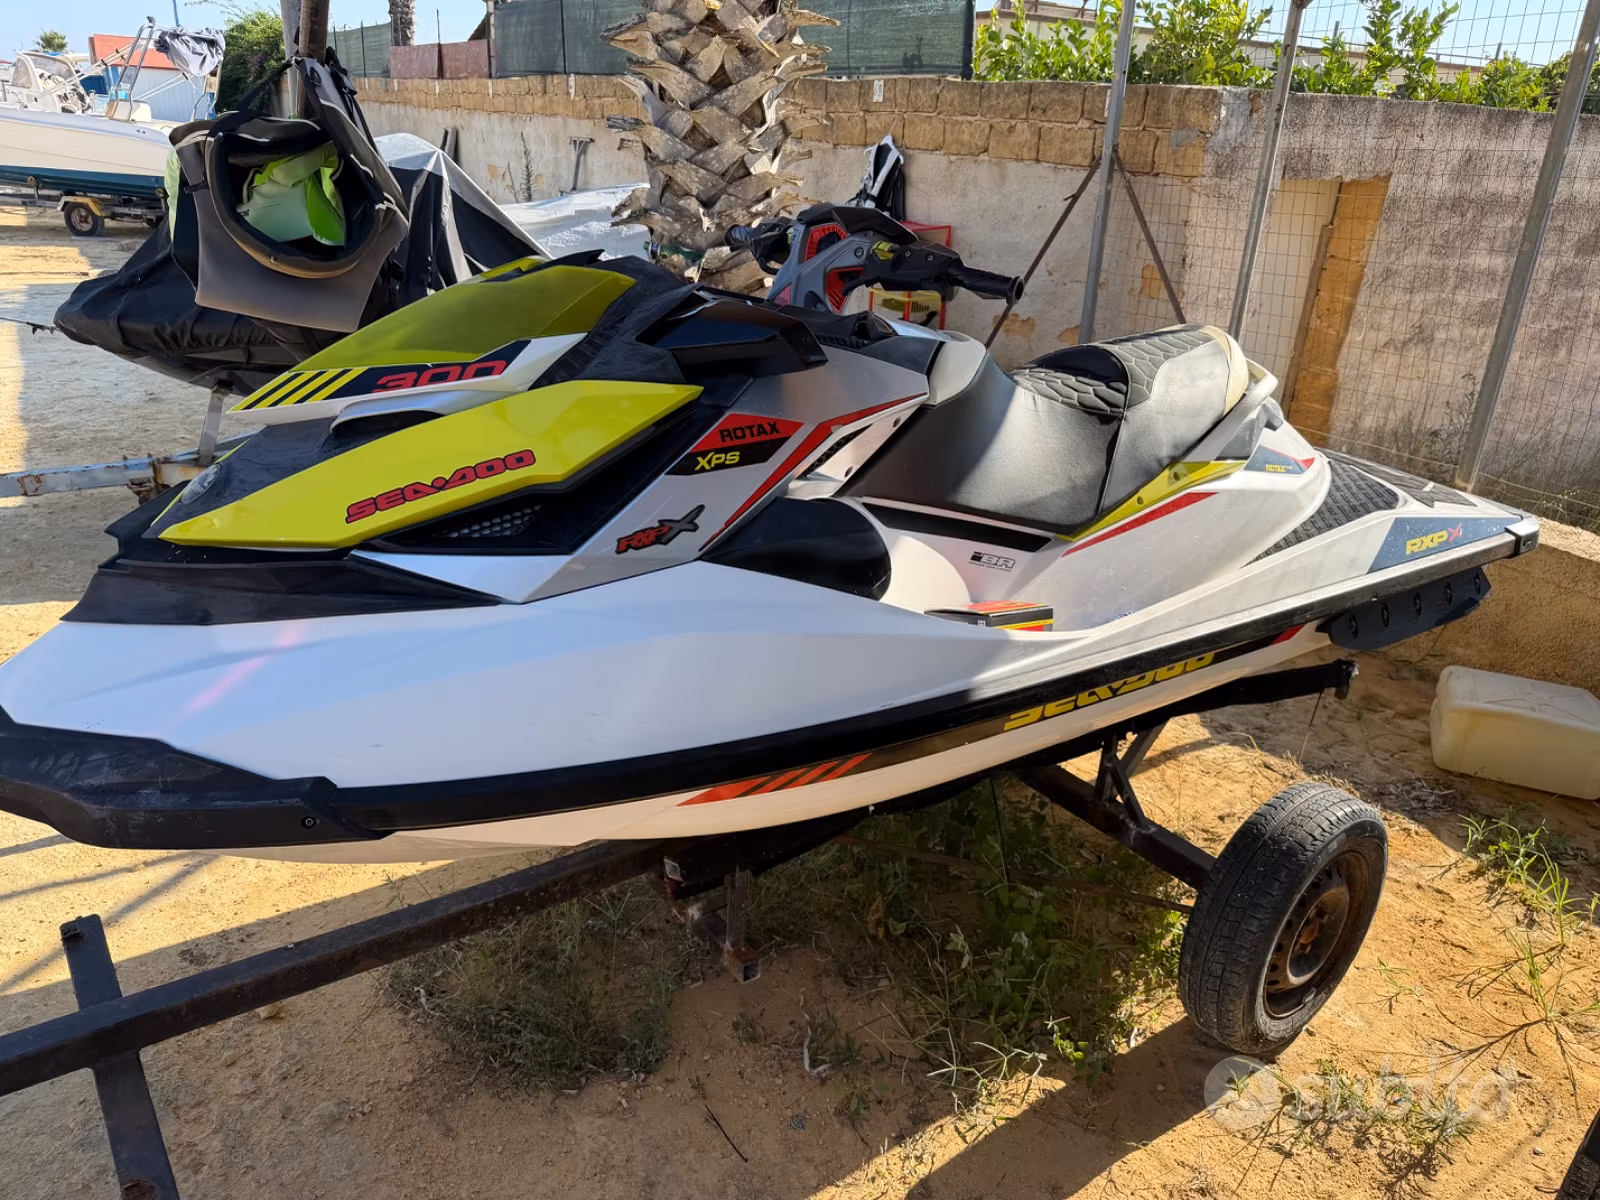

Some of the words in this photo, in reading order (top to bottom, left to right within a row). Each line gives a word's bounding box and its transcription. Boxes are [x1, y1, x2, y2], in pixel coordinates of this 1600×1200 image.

[372, 360, 507, 393] 300
[719, 421, 780, 443] ROTAX
[695, 452, 741, 471] XPS
